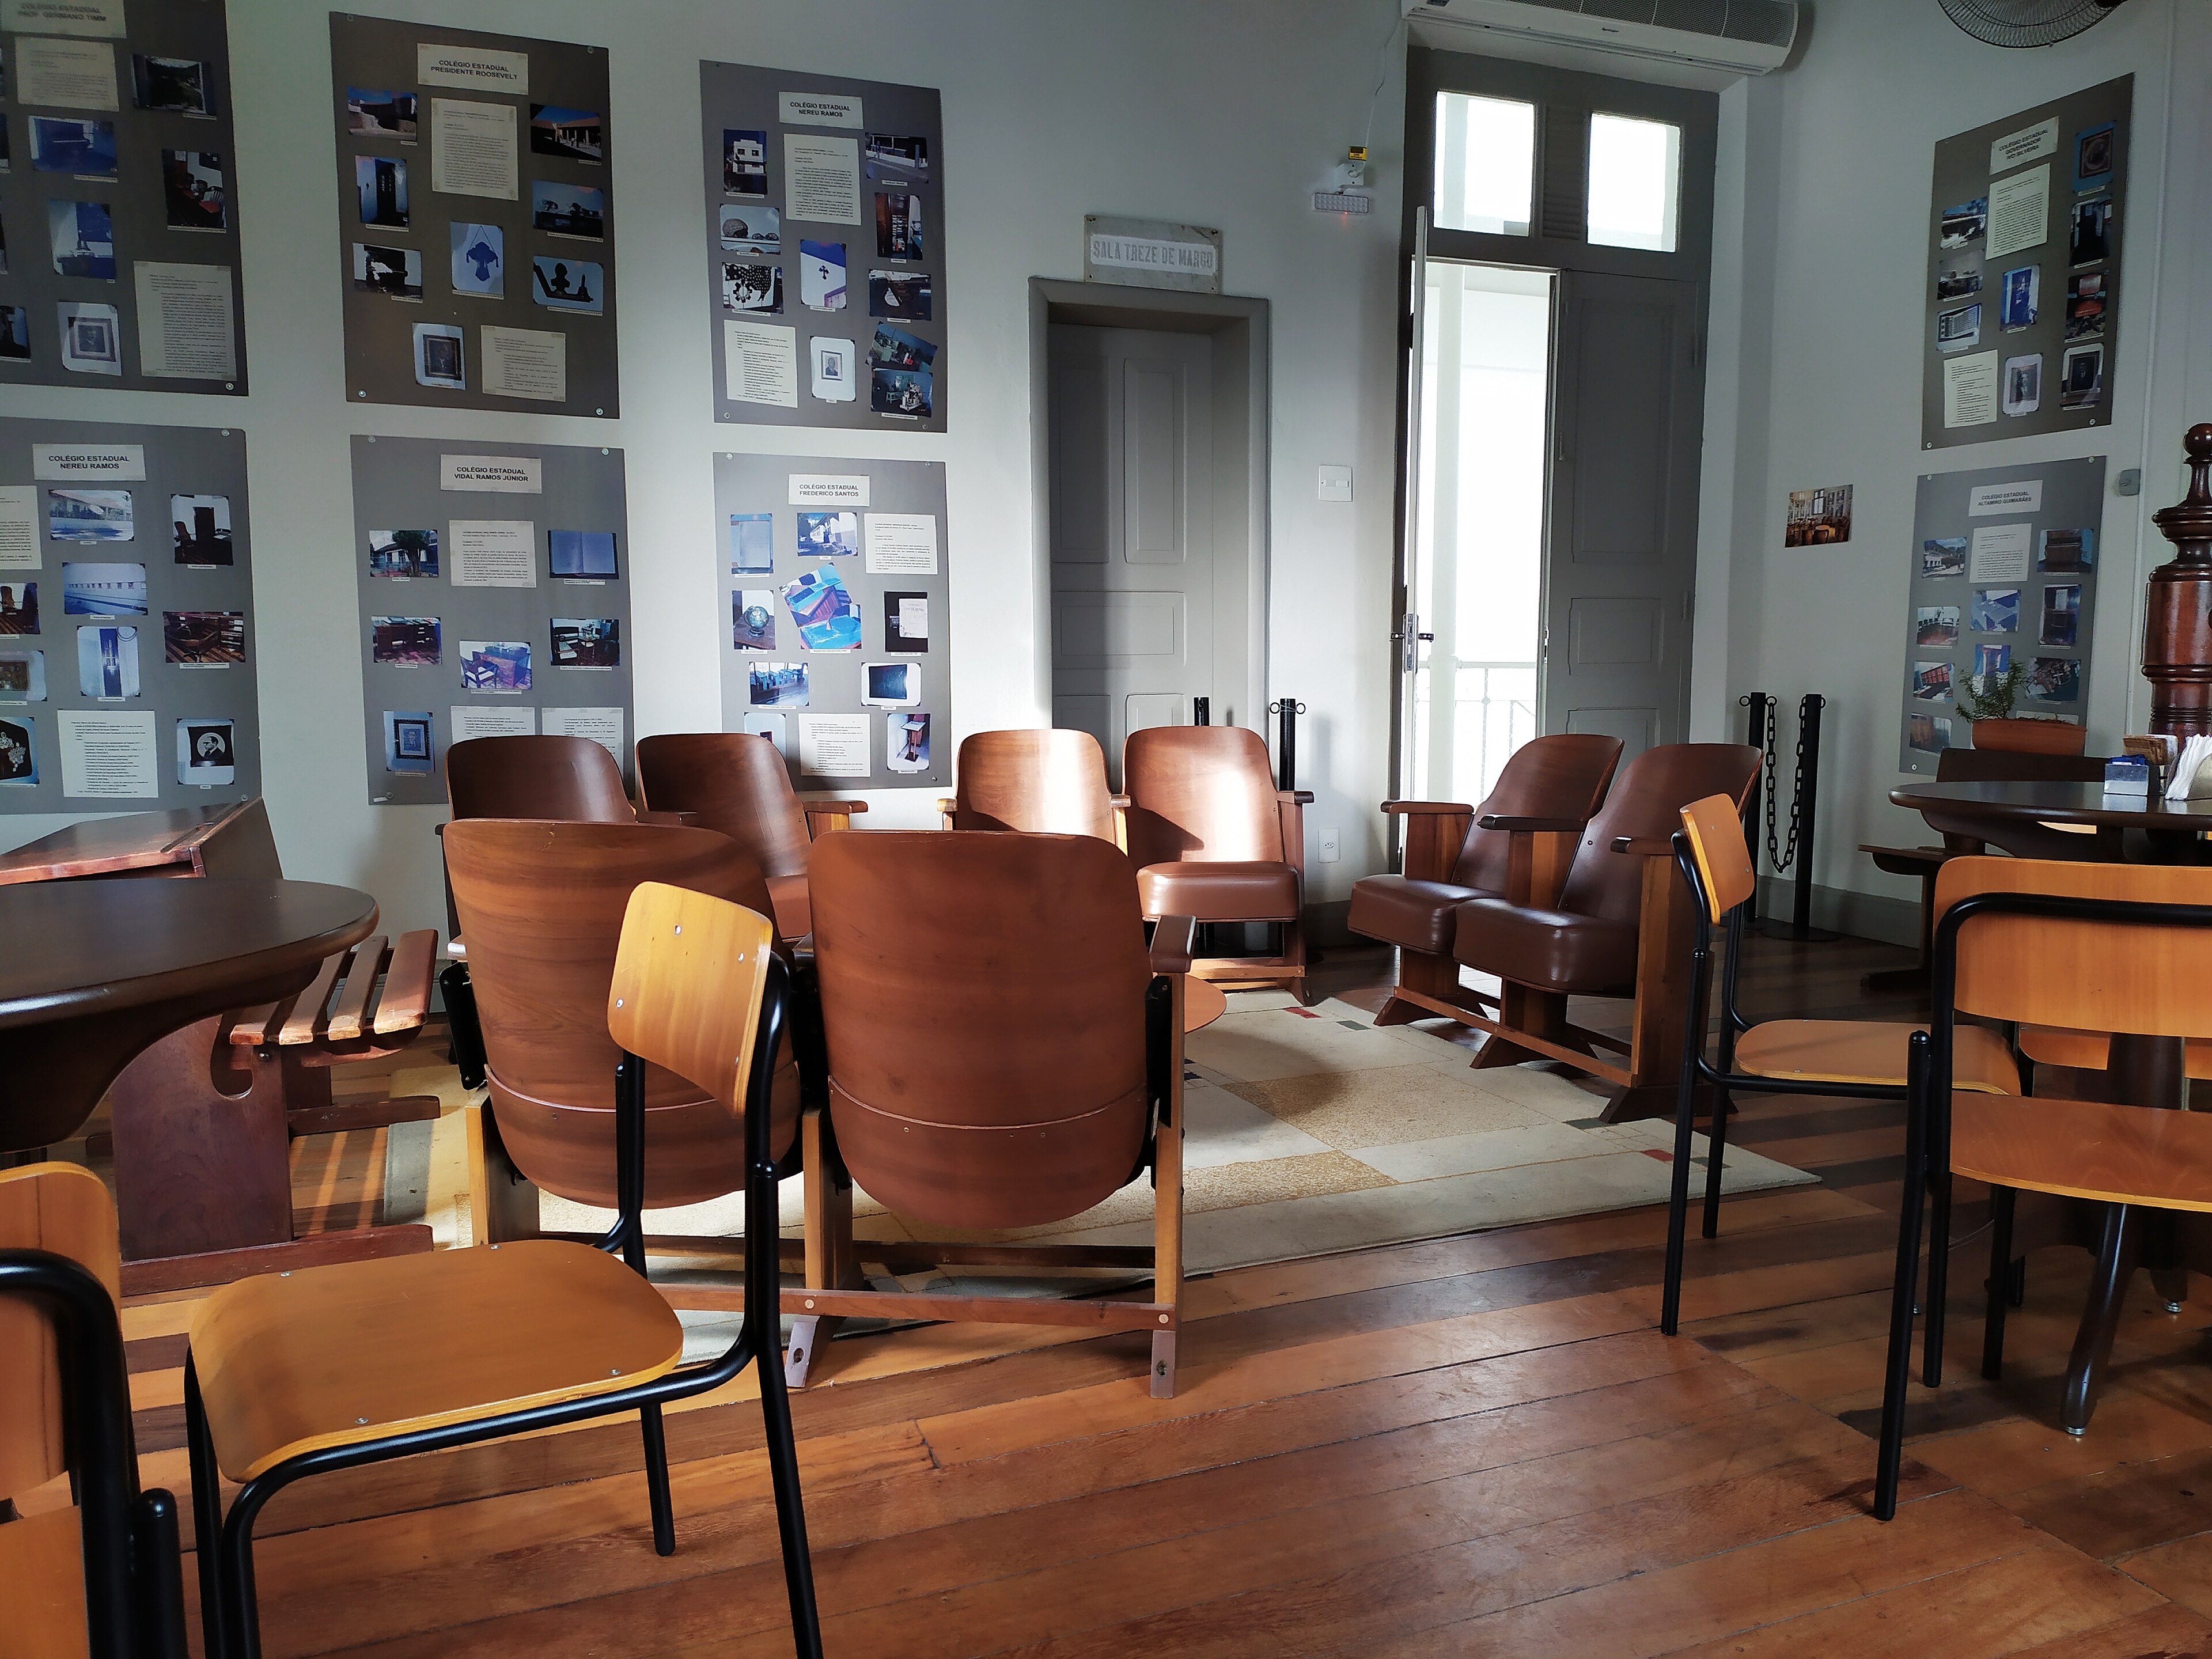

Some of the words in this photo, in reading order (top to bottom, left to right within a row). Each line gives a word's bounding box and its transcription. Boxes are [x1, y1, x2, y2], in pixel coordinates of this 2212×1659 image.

[430, 66, 474, 75] PRESIDENTE
[475, 70, 518, 79] ROOSEVELT
[439, 60, 471, 68] COLÉGIO
[472, 63, 509, 72] ESTADUAL
[1092, 240, 1121, 260] SALA
[1123, 243, 1158, 264] TREZE
[1161, 247, 1175, 266] DE
